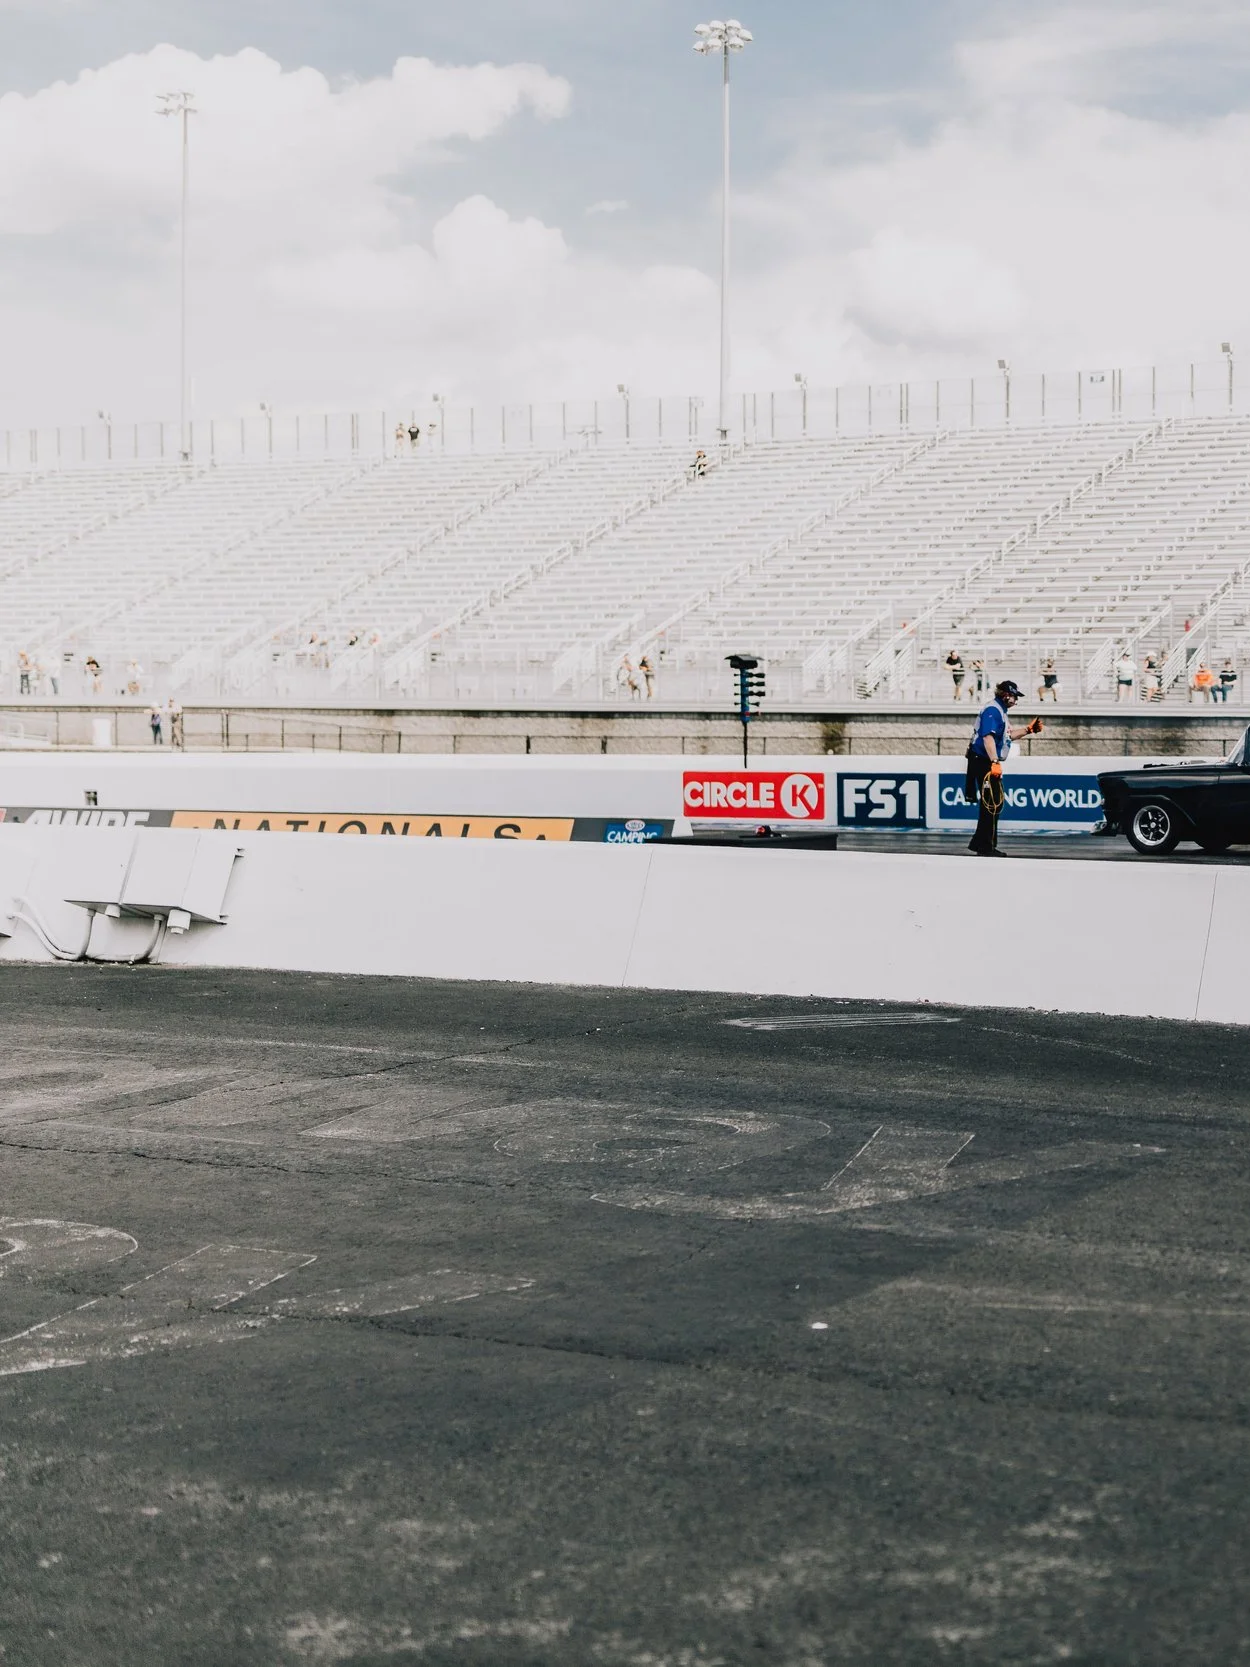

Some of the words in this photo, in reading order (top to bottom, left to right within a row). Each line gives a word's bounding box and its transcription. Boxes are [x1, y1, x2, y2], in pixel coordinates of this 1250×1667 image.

[684, 781, 775, 808] CIRCLE
[789, 782, 816, 818] K
[843, 779, 920, 818] FS1
[941, 787, 1028, 807] CANG
[1029, 788, 1102, 808] WORLD
